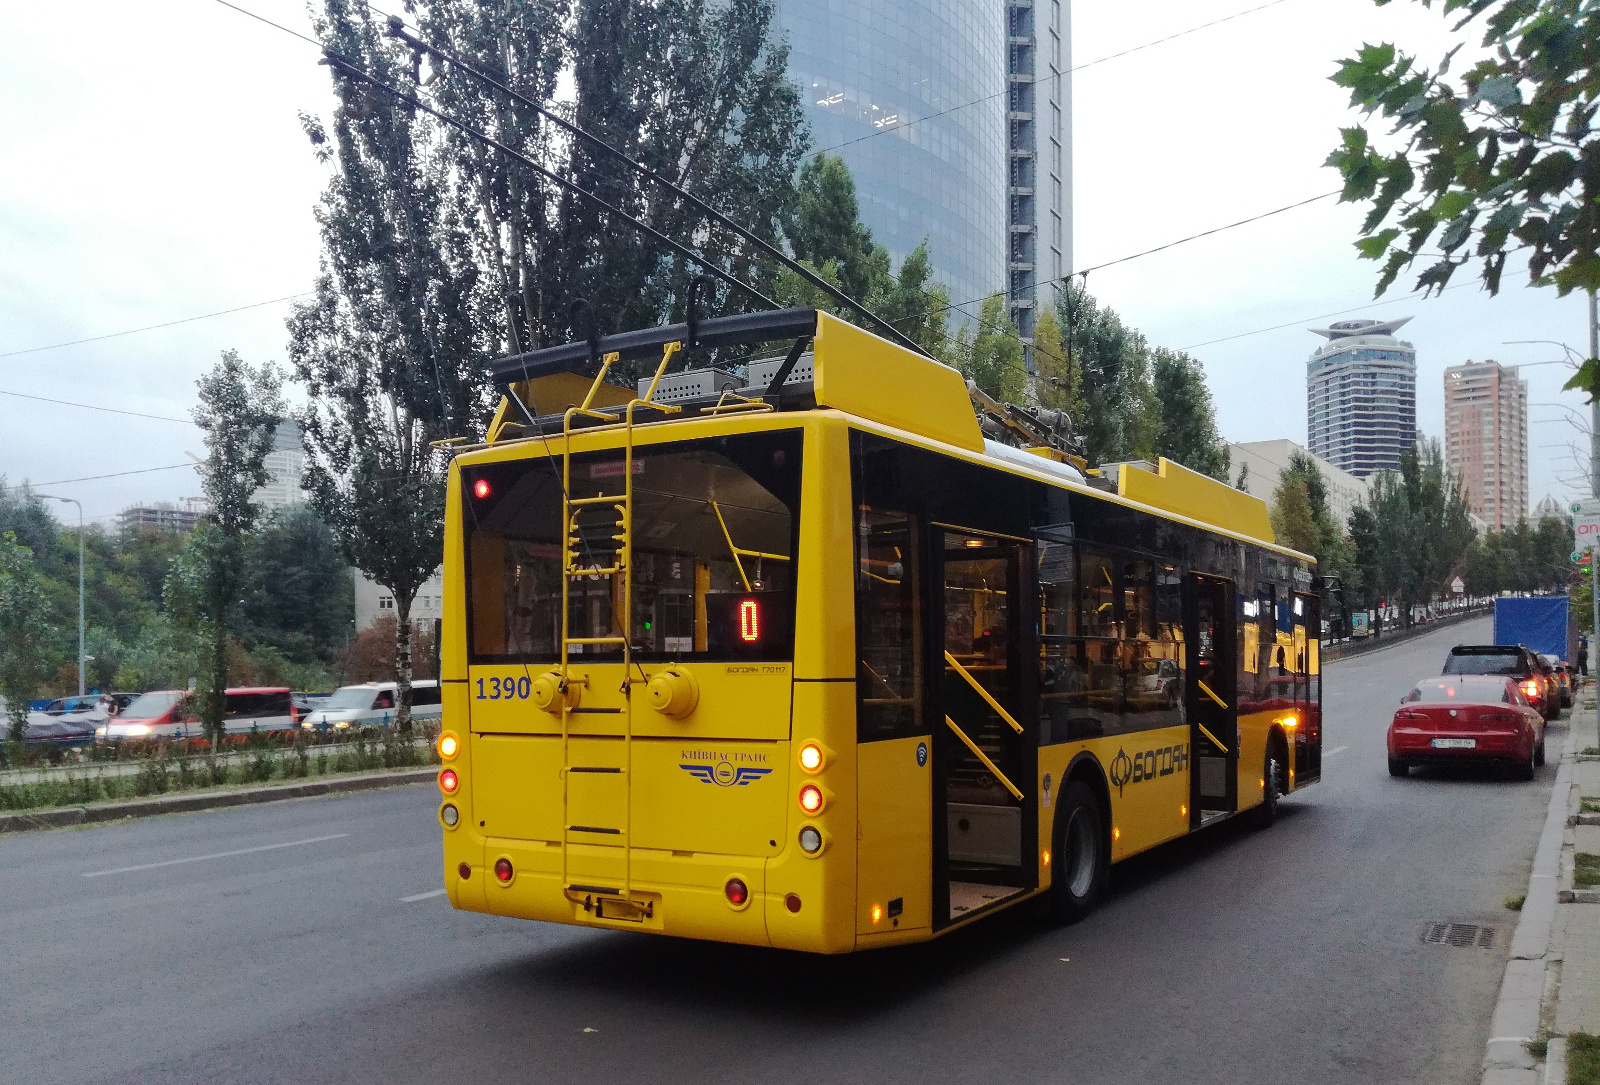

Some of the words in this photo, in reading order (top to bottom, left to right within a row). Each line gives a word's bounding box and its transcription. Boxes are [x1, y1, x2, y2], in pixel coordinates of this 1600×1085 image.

[1577, 524, 1600, 535] an
[476, 676, 531, 700] 1390
[681, 749, 770, 762] КИЇВПАСТРАНС
[1132, 743, 1190, 783] БОГДАН
